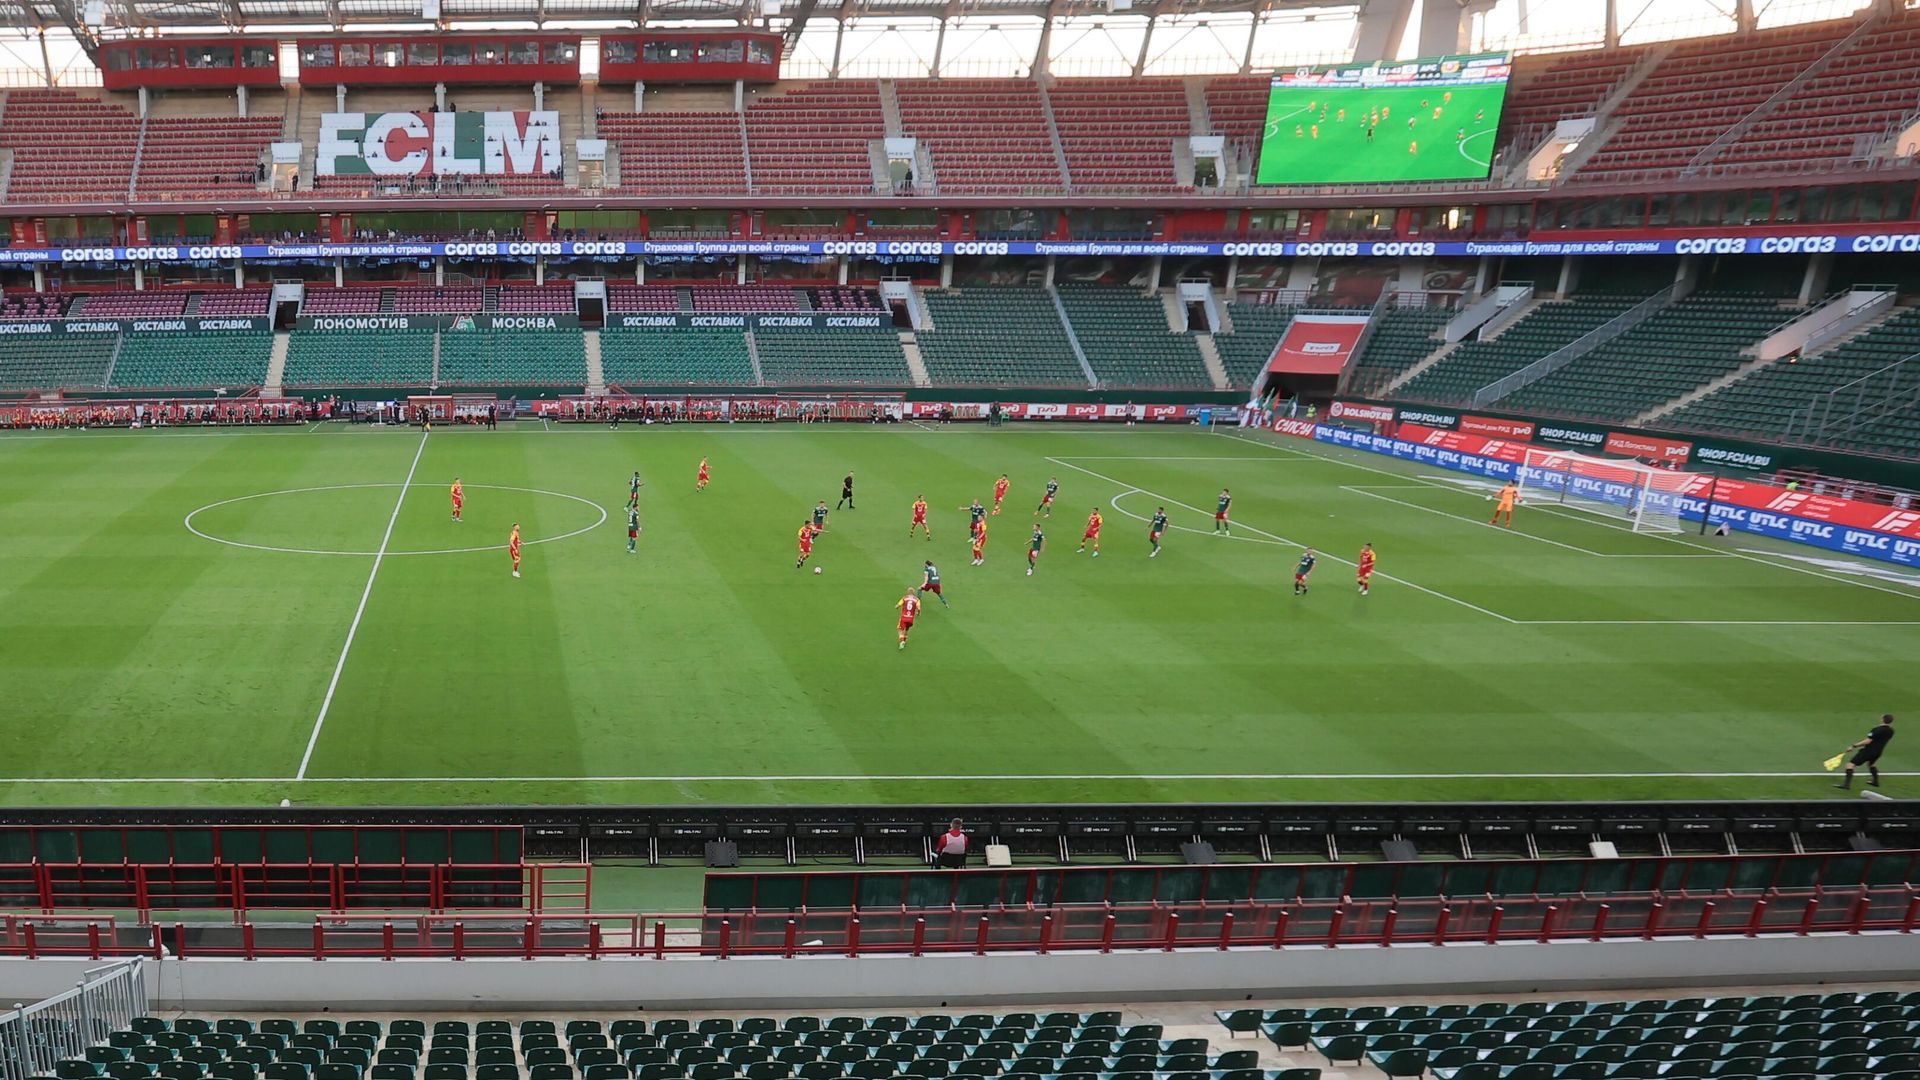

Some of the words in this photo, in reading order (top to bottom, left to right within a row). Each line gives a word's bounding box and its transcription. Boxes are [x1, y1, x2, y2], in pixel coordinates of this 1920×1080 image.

[316, 111, 563, 175] FCLM
[268, 245, 317, 257] Страховая
[319, 245, 350, 256] Группа
[351, 247, 370, 256] для
[371, 244, 394, 254] всей
[396, 247, 431, 256] страны
[445, 243, 497, 255] согаз
[508, 243, 561, 255] согаз
[573, 242, 625, 254] согаз
[644, 242, 694, 254] Страховая
[696, 242, 728, 254] Группа
[729, 244, 747, 253] для
[749, 242, 772, 252] всей
[774, 244, 810, 254] страны
[823, 242, 876, 254] согаз
[888, 242, 942, 255] согаз
[954, 243, 1008, 255] согаз
[1035, 243, 1087, 255] Страховая
[1088, 243, 1122, 255] Группа
[1123, 246, 1142, 255] для
[1143, 243, 1168, 253] всей
[1169, 246, 1209, 255] страны
[1223, 243, 1282, 255] согаз
[1296, 243, 1358, 255] согаз
[1372, 243, 1435, 255] согаз
[1466, 242, 1524, 255] Страховая
[1525, 242, 1561, 255] Группа
[1562, 244, 1584, 254] для
[1585, 241, 1614, 252] всей
[1615, 242, 1660, 254] страны
[1675, 238, 1747, 254] согаз
[1761, 237, 1837, 253] согаз
[13, 252, 48, 262] страны
[62, 249, 114, 261] согаз
[126, 248, 178, 260] согаз
[190, 247, 241, 259] согаз
[313, 317, 409, 330] ЛОКОМОТИВ
[492, 317, 556, 329] МОСКВА
[1400, 411, 1456, 425] SHOP.FCLM.RU
[1539, 427, 1604, 443] SHOP.FCLM.RU
[1697, 447, 1771, 466] SHOP.FCLM.RU
[1894, 540, 1920, 557] UT
[906, 600, 913, 611] 6
